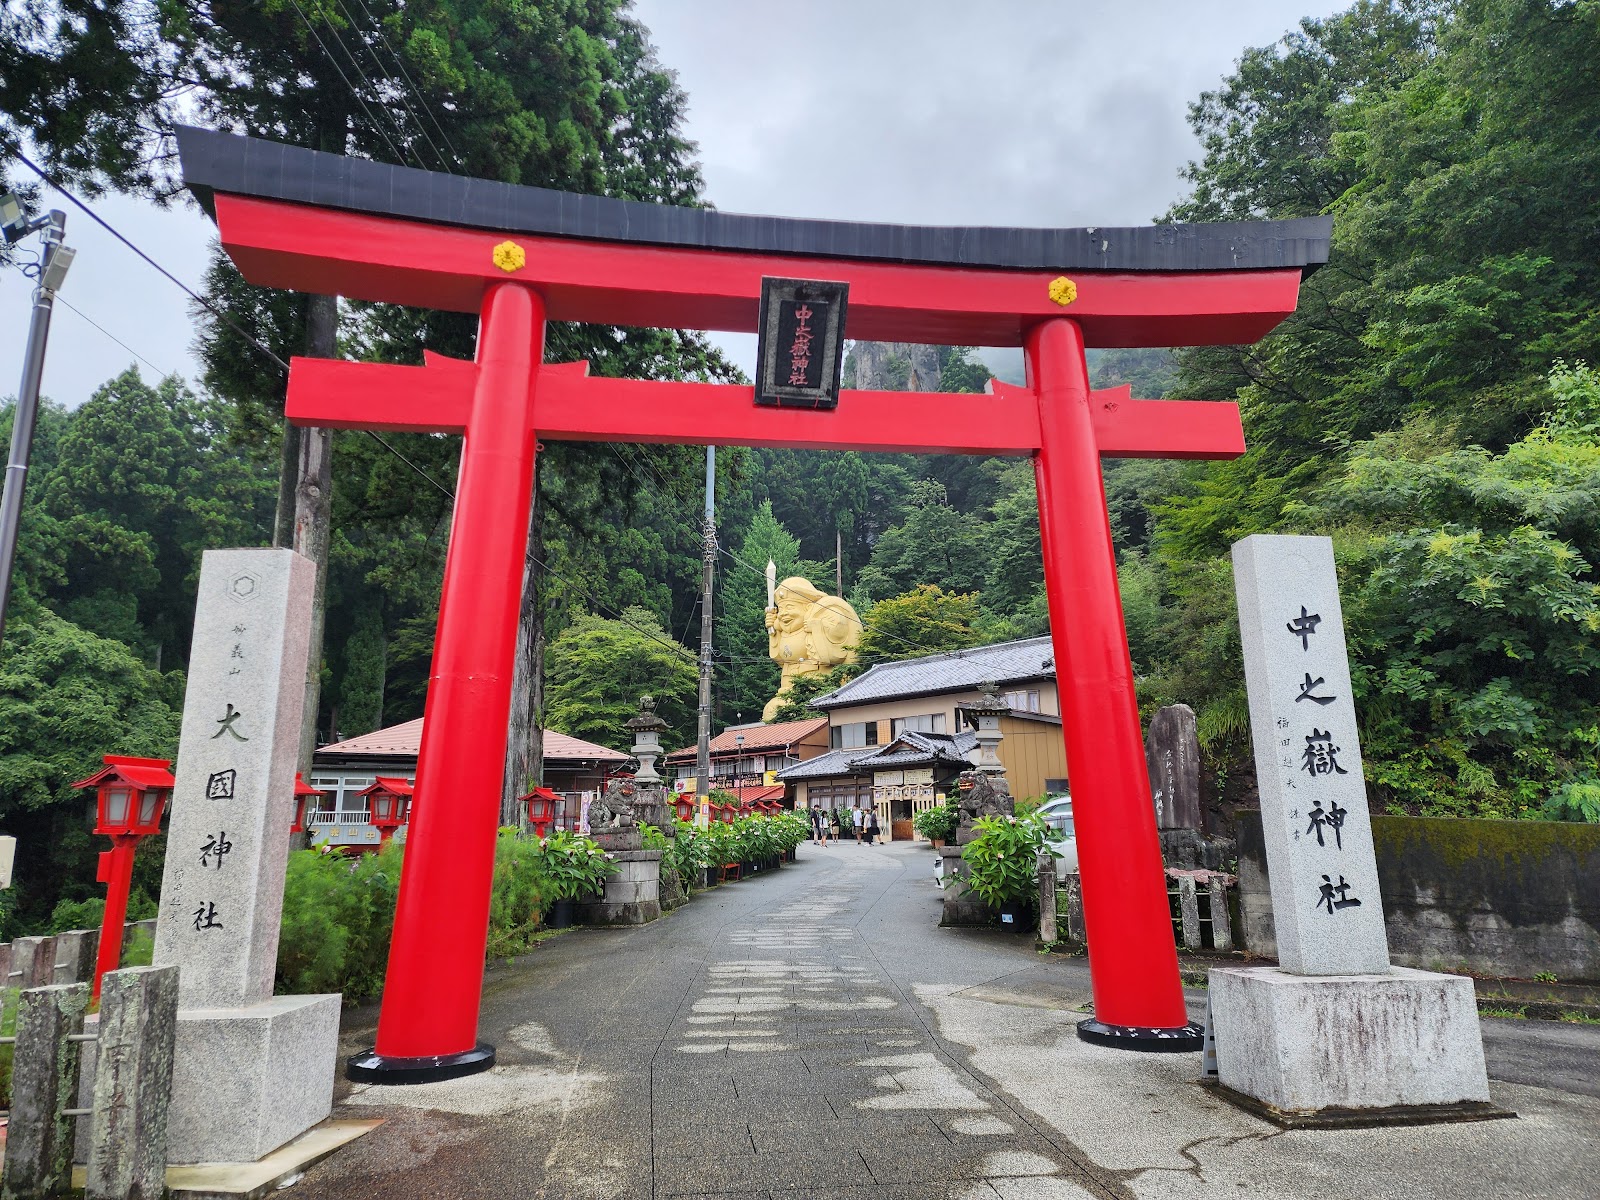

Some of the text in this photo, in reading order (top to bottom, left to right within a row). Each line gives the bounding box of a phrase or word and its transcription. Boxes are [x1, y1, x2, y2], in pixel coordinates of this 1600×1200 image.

[191, 703, 250, 932] 大國神社
[1286, 604, 1362, 915] 中之嶽神社
